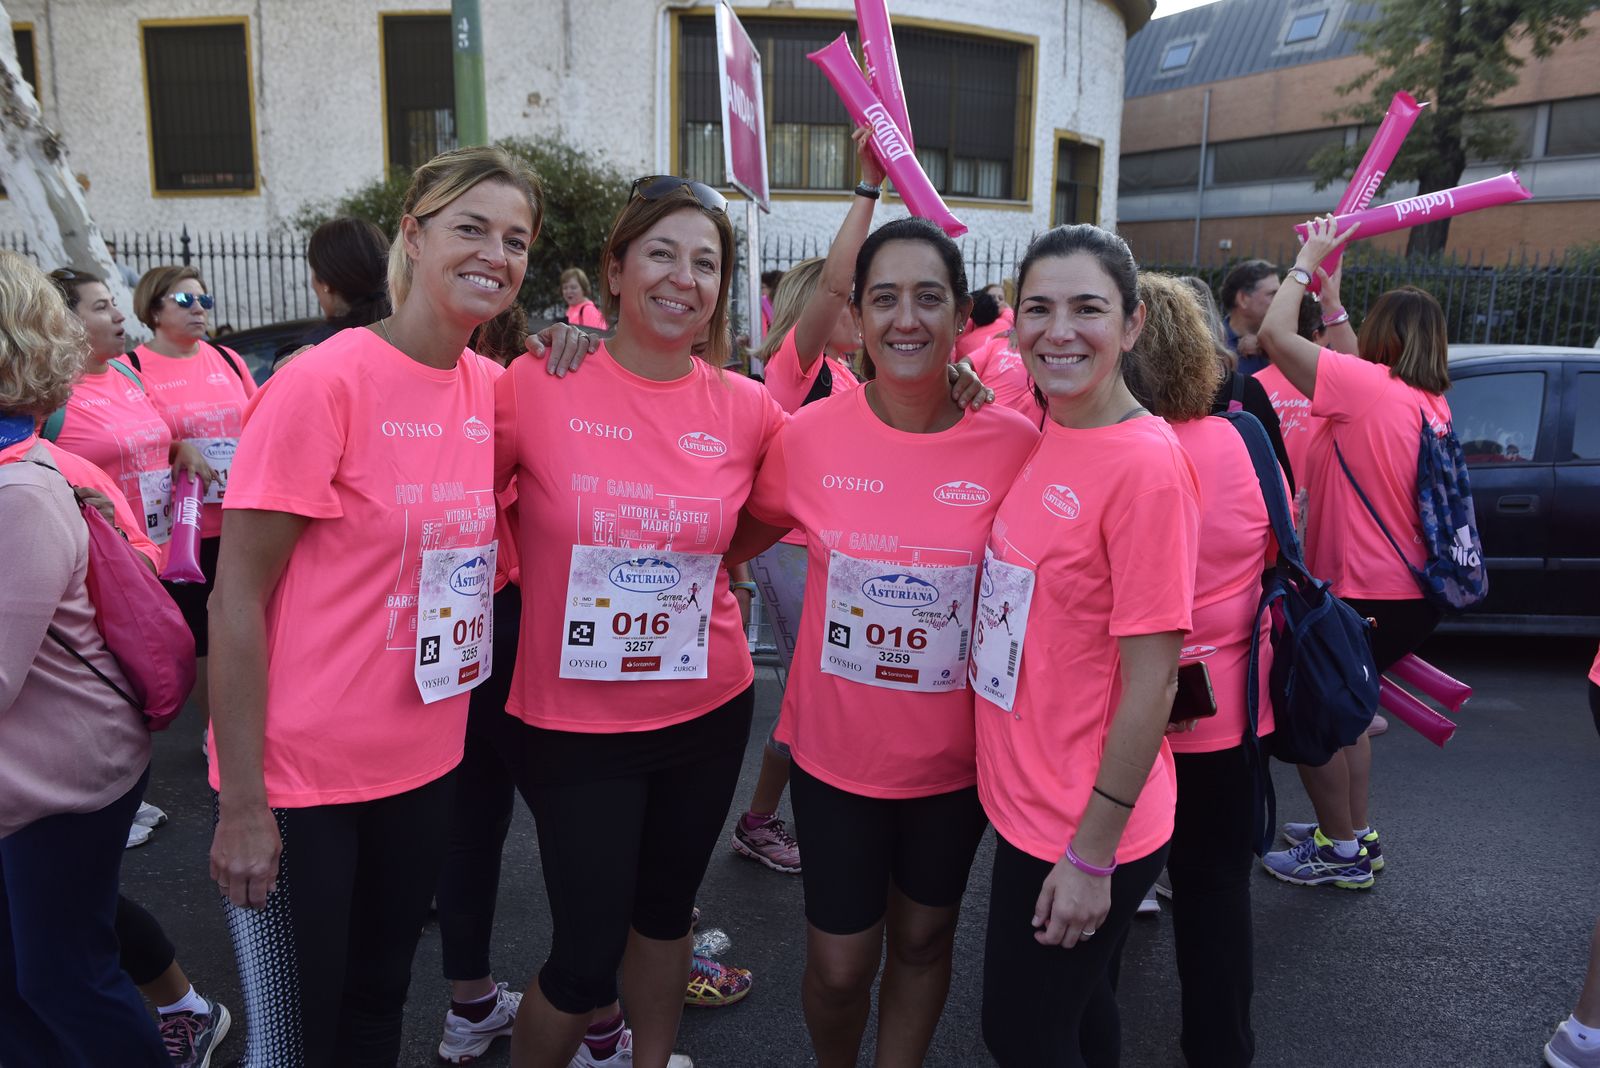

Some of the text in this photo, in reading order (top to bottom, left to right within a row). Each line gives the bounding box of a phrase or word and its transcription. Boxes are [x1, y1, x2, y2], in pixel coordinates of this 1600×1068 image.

[863, 103, 913, 162] Ladival
[1394, 191, 1455, 222] Ladival
[381, 420, 443, 438] OYSHO
[569, 418, 633, 441] OYSHO
[571, 473, 654, 500] HOY GANAN
[822, 474, 884, 494] OYSHO
[396, 484, 424, 504] HOY
[937, 489, 986, 501] ASTURIANA
[182, 496, 202, 531] Ladival
[621, 504, 659, 520] VITORIA
[668, 510, 708, 524] GASTEIZ
[641, 519, 681, 533] MADRID
[849, 532, 899, 552] GANAN
[614, 569, 675, 584] ASTURIANA
[656, 592, 684, 601] Carrera
[867, 583, 934, 601] ASTURIANA
[912, 608, 942, 619] Carrera
[453, 614, 484, 646] 016
[612, 612, 670, 636] 016
[928, 618, 949, 630] Mujer
[866, 623, 928, 650] 016
[461, 646, 478, 662] 3255
[625, 641, 654, 652] 3257
[569, 659, 608, 669] OYSHO
[829, 655, 862, 672] OYSHO
[878, 651, 910, 664] 3259
[422, 676, 450, 690] OYSHO
[887, 671, 913, 679] Santander
[983, 685, 1005, 699] ZURICH
